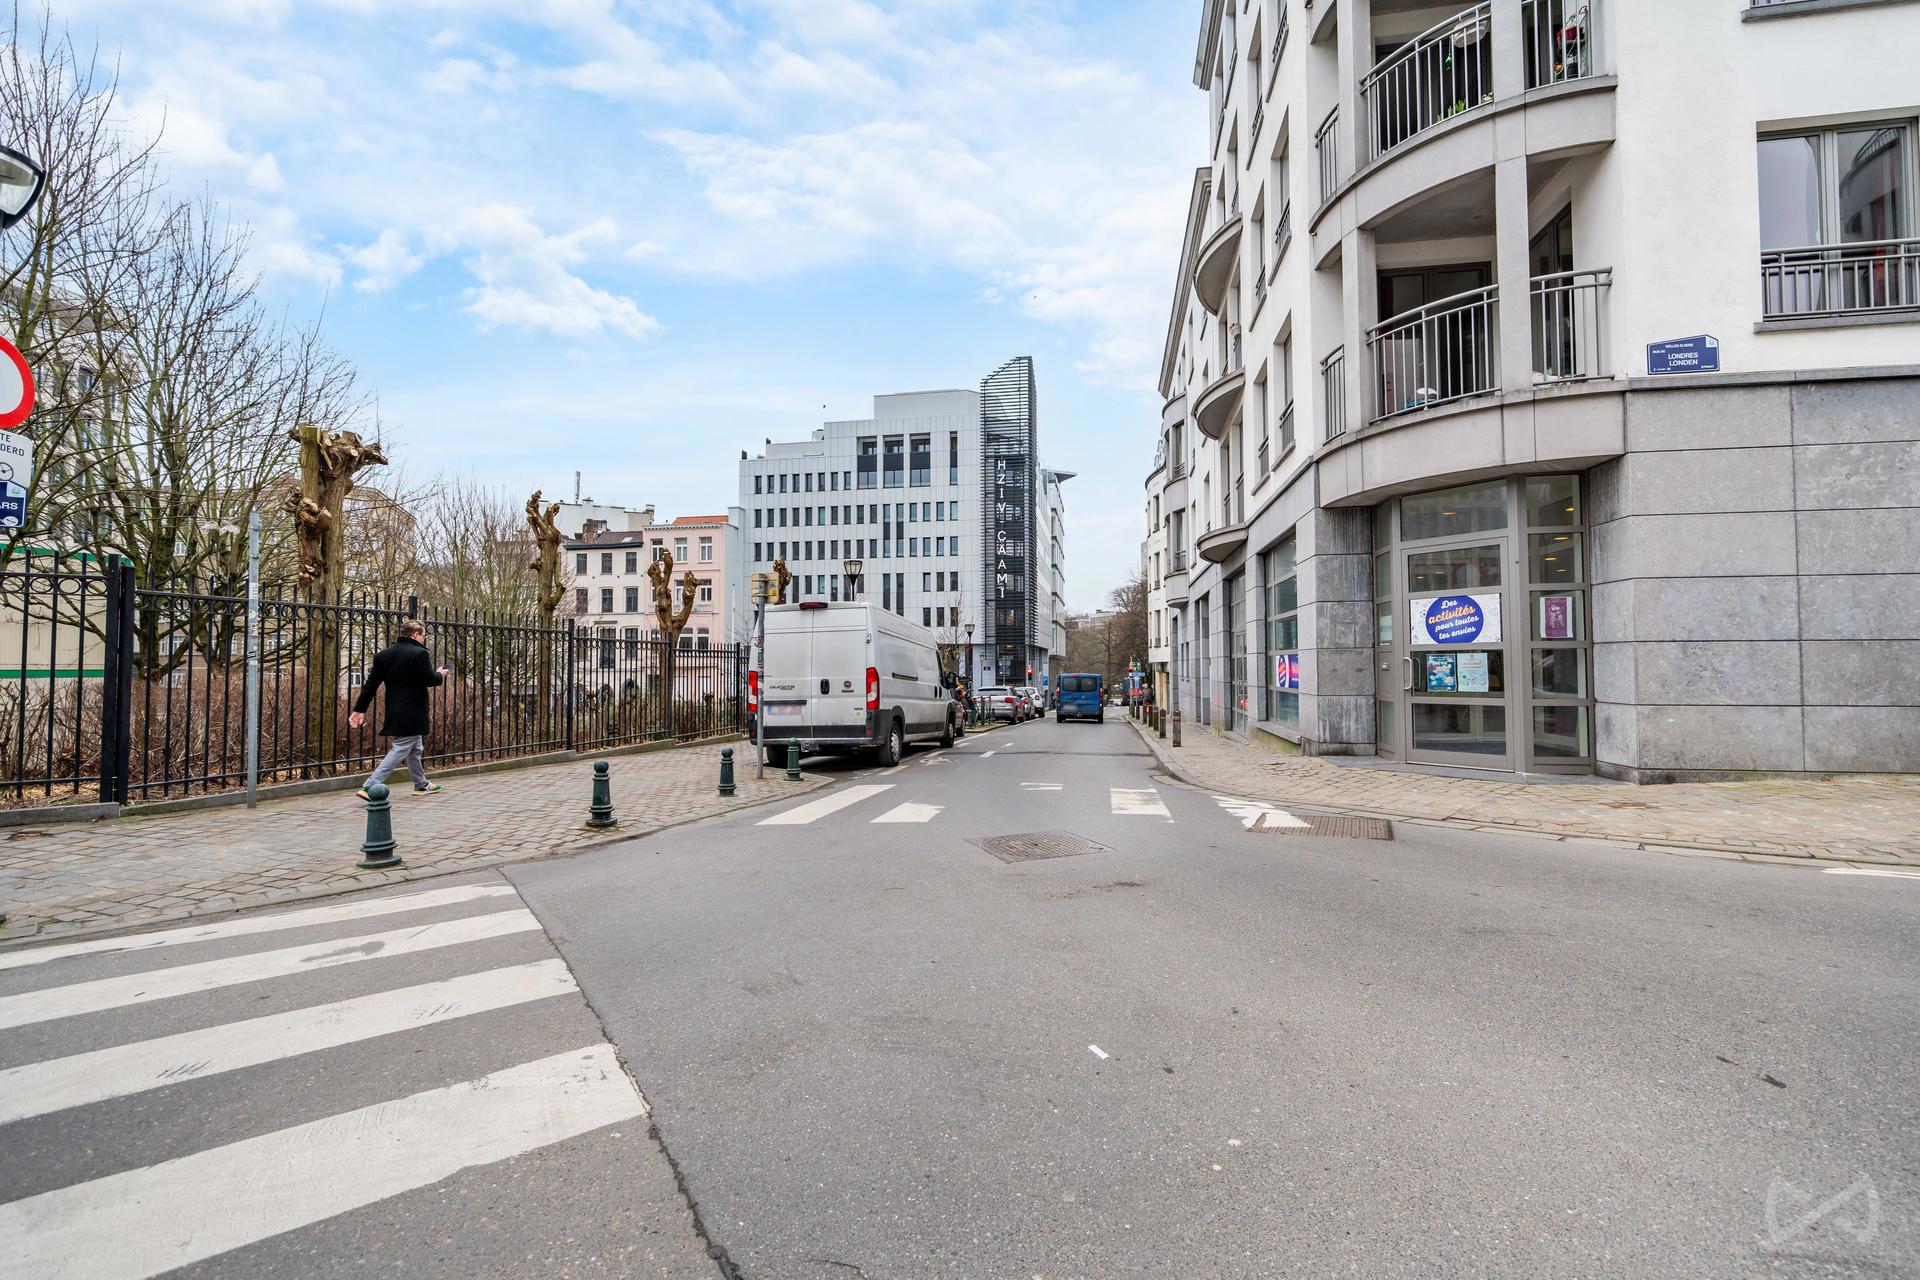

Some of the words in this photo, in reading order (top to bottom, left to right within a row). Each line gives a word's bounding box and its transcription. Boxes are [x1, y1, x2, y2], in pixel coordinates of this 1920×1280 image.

[1668, 352, 1699, 360] LONDRES
[0, 443, 25, 457] DERD
[1441, 600, 1458, 609] Des
[1429, 605, 1476, 624] activités
[1435, 621, 1455, 633] pour
[1455, 615, 1480, 626] toutes
[1452, 626, 1476, 636] envies
